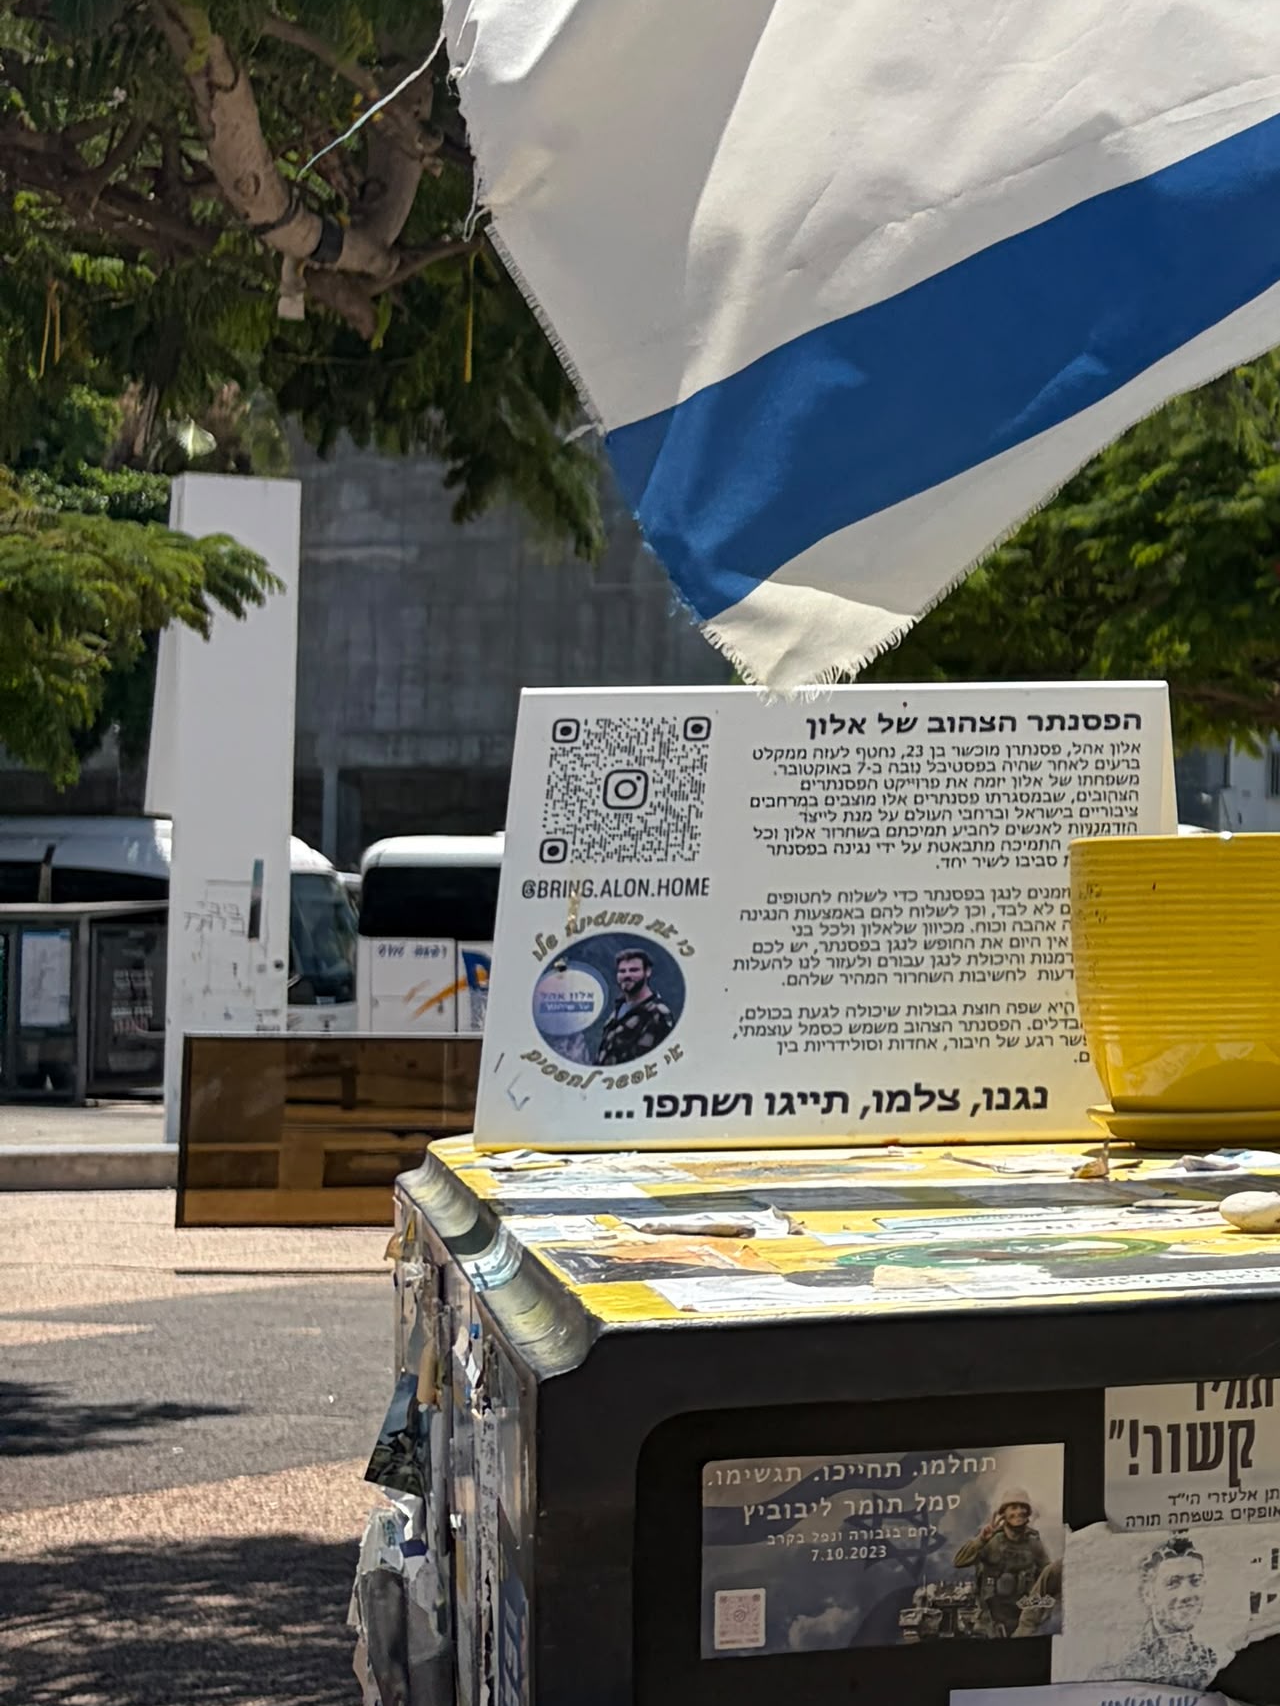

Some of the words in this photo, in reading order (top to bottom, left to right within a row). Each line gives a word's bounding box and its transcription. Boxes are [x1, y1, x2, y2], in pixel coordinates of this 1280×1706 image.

[806, 713, 866, 739] אלון
[878, 713, 918, 733] של
[928, 715, 1016, 733] הצהוב
[1027, 713, 1141, 731] הפסנתר
[753, 747, 807, 762] ממקלט
[813, 746, 850, 759] לעזה
[856, 747, 895, 763] נחטף
[901, 745, 923, 759] 23,
[930, 747, 945, 759] בן
[952, 745, 1000, 756] מוכשר
[1006, 744, 1061, 758] פסנתרן
[1067, 742, 1104, 757] אהל,
[1110, 741, 1140, 757] אלון
[800, 810, 837, 823] לייצר
[843, 811, 872, 823] מנת
[878, 809, 898, 822] על
[904, 808, 952, 821] העולם
[958, 809, 1008, 820] וברחבי
[1015, 806, 1073, 819] בישראל
[1080, 806, 1138, 818] ציבוריים
[643, 1093, 752, 1118] ושתפו
[764, 1091, 849, 1115] תייגו
[860, 1083, 960, 1119] צלמו,
[970, 1086, 1048, 1117] נגנו,
[604, 1111, 634, 1119] ...
[1108, 1419, 1255, 1488] קשור!"
[814, 1462, 901, 1481] תחייכו.
[912, 1454, 997, 1477] תחלמו.
[708, 1467, 802, 1486] תגשימו.
[1168, 1493, 1200, 1505] הי"ד
[1208, 1487, 1258, 1503] אלעזרי
[743, 1496, 832, 1525] ליבוביץ
[840, 1498, 903, 1517] תומר
[1126, 1514, 1160, 1528] תורה
[812, 1545, 886, 1561] 7.10.2023
